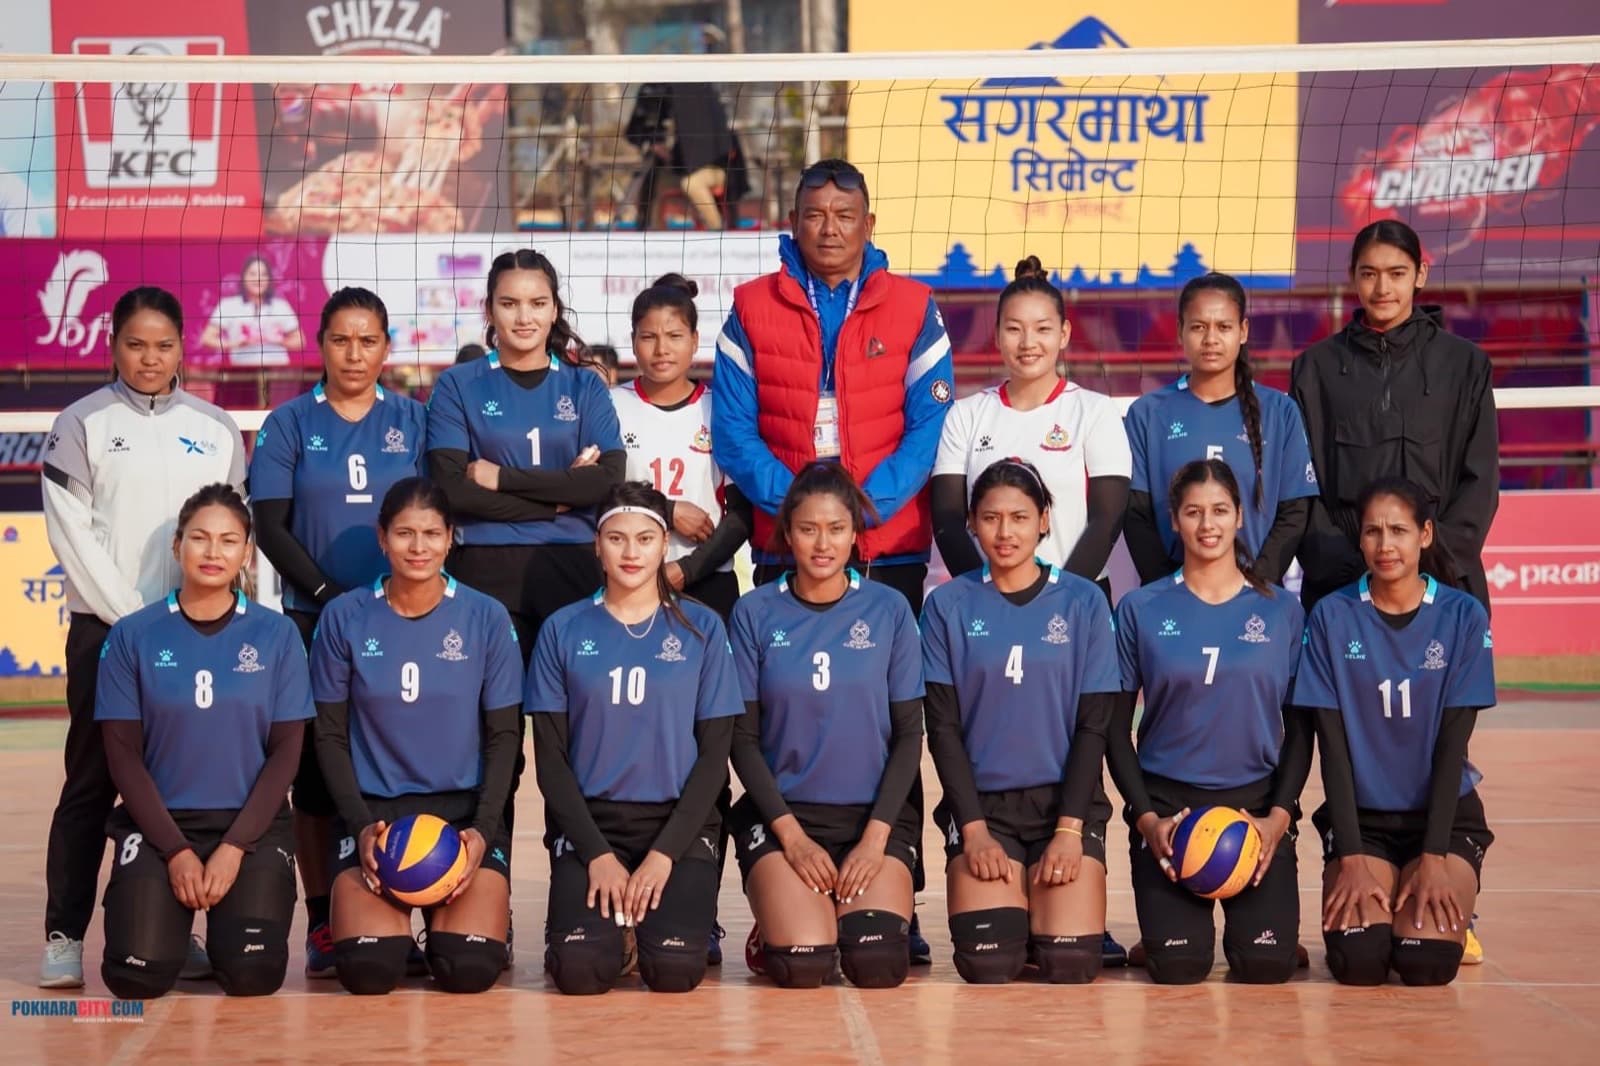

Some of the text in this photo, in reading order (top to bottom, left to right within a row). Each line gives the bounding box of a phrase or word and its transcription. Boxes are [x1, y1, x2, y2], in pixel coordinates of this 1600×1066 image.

[306, 0, 444, 49] CHIZZA
[940, 94, 1210, 143] सगरमाथा
[109, 149, 196, 179] KFC
[1009, 146, 1138, 191] सिमेन्ट
[526, 427, 541, 466] 1
[347, 454, 367, 491] 6
[649, 457, 684, 496] 12
[400, 661, 420, 703] 9
[812, 651, 831, 691] 3
[1004, 645, 1024, 685] 4
[1202, 647, 1220, 685] 7
[194, 669, 214, 709] 8
[608, 666, 646, 706] 10
[1378, 678, 1411, 718] 11
[119, 832, 143, 866] 8
[748, 826, 767, 851] 3
